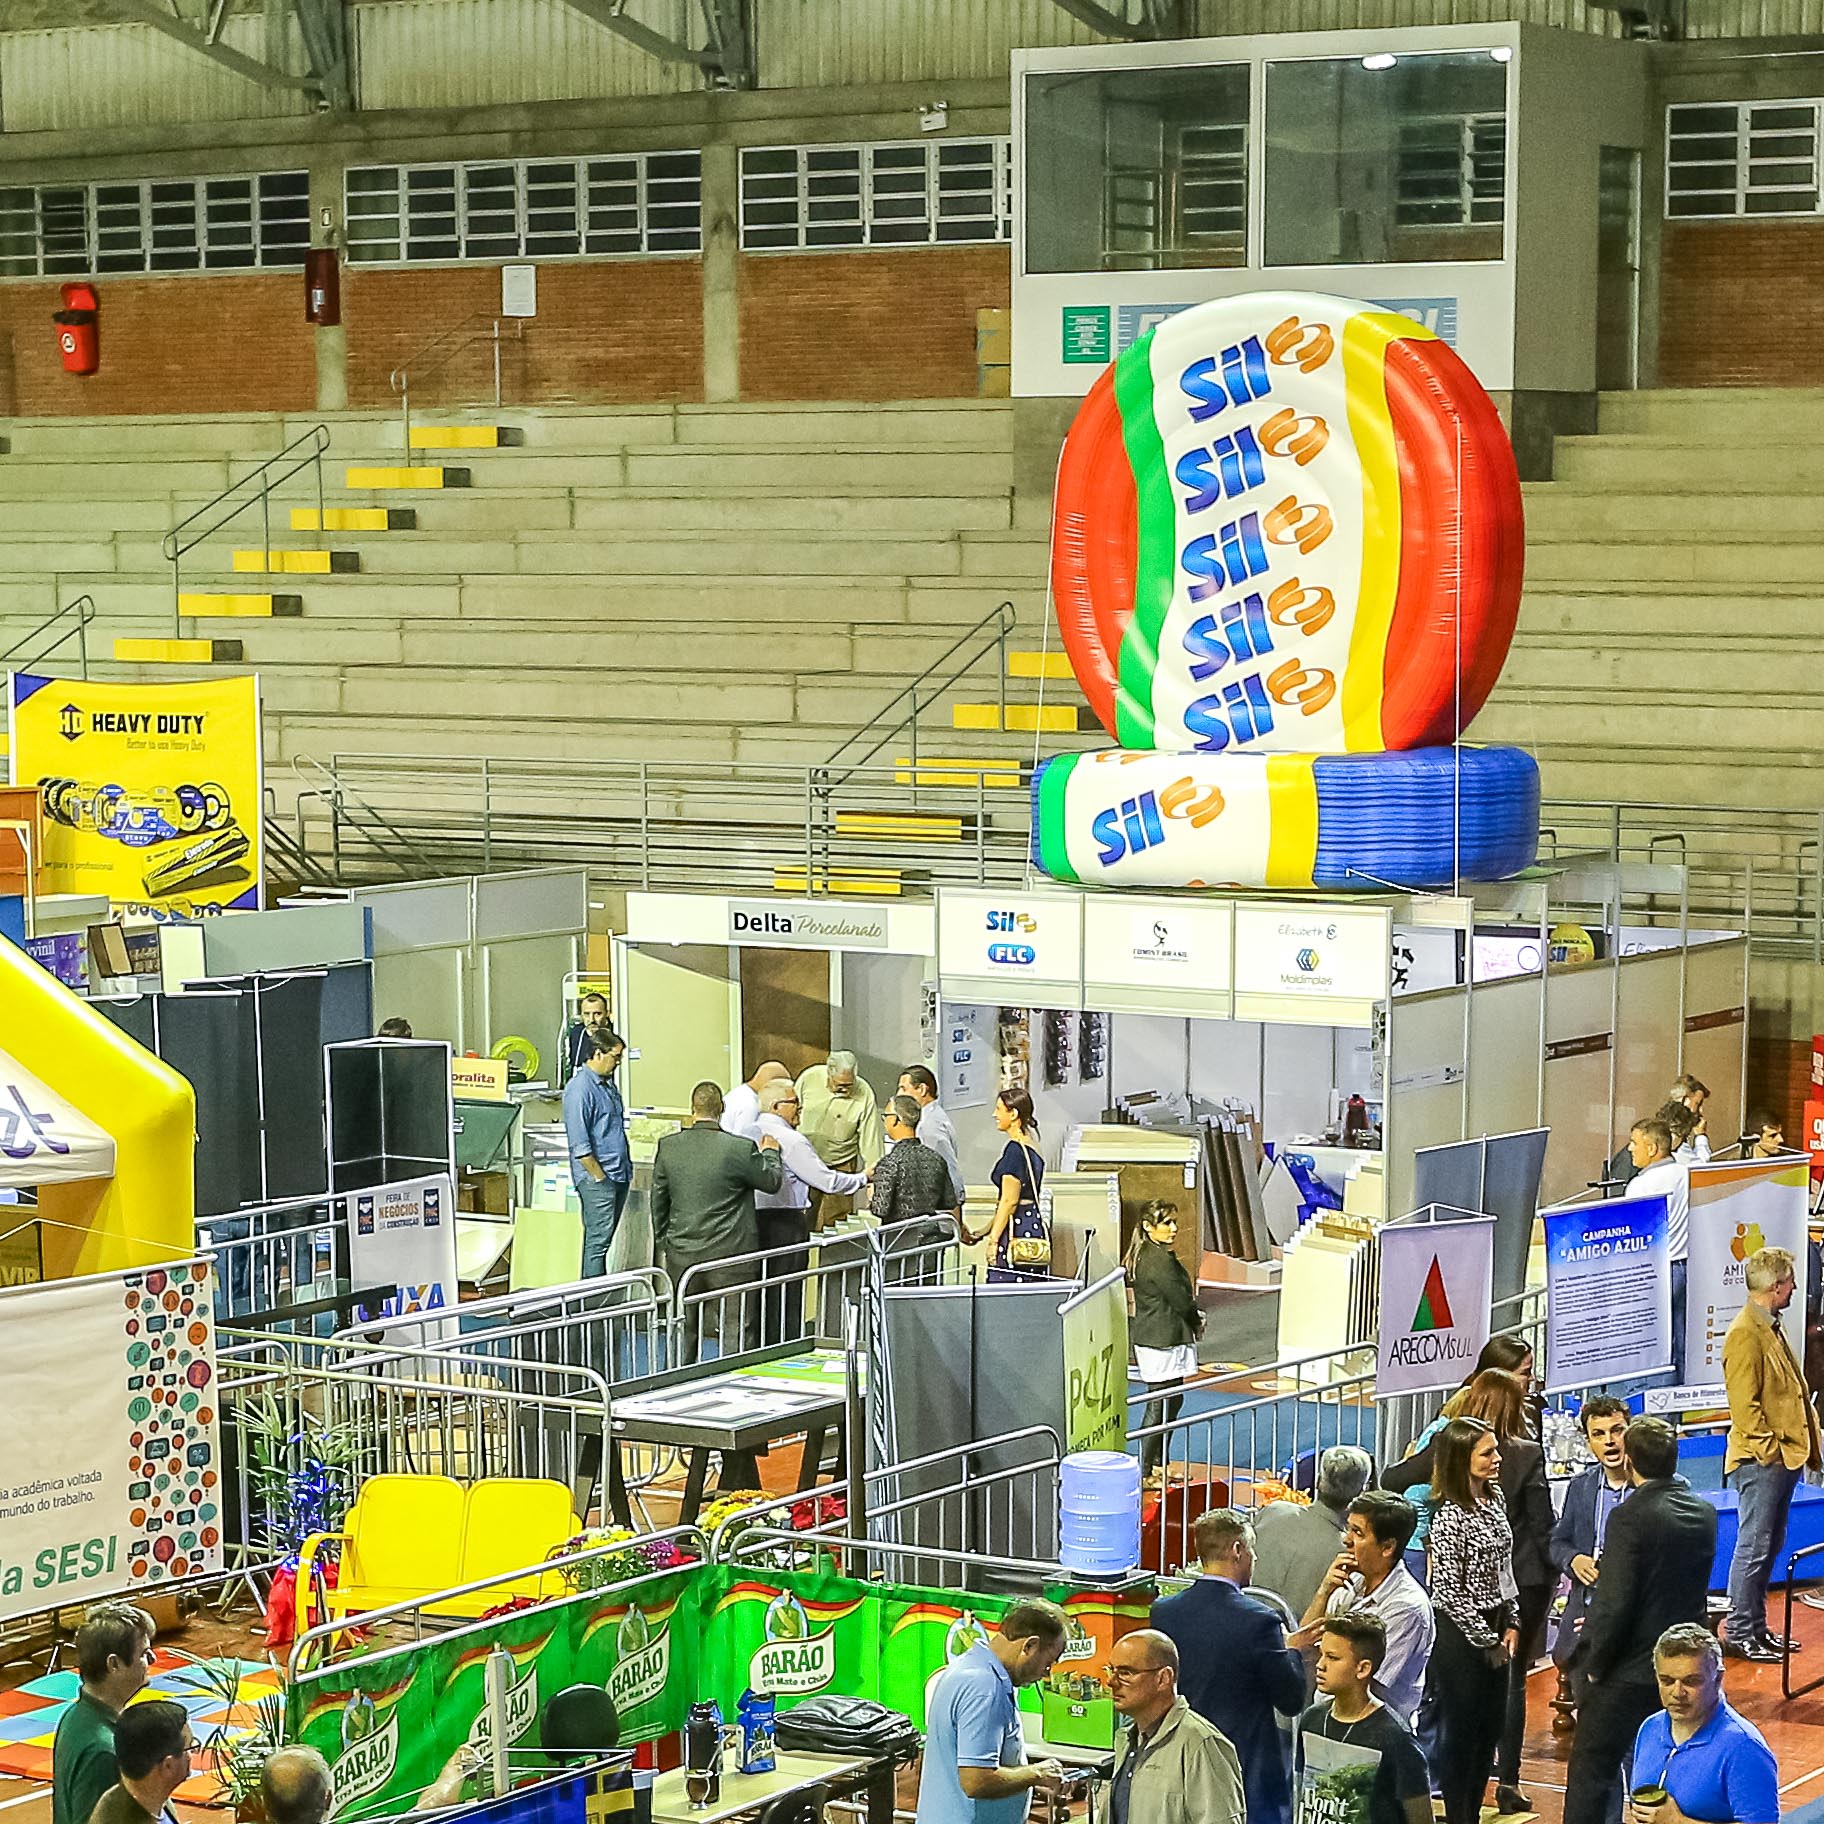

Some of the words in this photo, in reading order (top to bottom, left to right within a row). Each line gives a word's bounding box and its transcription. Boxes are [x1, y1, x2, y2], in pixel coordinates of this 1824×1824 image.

[1181, 334, 1273, 425] Sil
[1175, 425, 1266, 515] Sil
[1181, 511, 1270, 603] Sil
[1183, 592, 1275, 682] Sil
[93, 714, 152, 735] HEAVY
[158, 714, 205, 734] DUTY
[1183, 673, 1275, 752] Sil
[1090, 789, 1166, 867] Sil
[733, 912, 792, 933] Delta
[796, 915, 882, 938] Porcelanato
[986, 911, 1014, 932] Sil
[995, 946, 1027, 962] FLC
[955, 1051, 969, 1061] FLC
[379, 1202, 419, 1220] NEGÓCIOS
[386, 1192, 402, 1202] FEIRA
[1583, 1225, 1631, 1242] CAMPANHA
[12, 1478, 64, 1498] acadêmica
[67, 1470, 102, 1487] voltada
[0, 1501, 34, 1519] mundo
[37, 1498, 50, 1512] do
[53, 1490, 95, 1508] trabalho.
[33, 1535, 117, 1589] SESI
[612, 1647, 663, 1700] BARÃO
[761, 1643, 824, 1677] BARÃO
[776, 1677, 798, 1687] Mate
[334, 1735, 390, 1794] BARÃO
